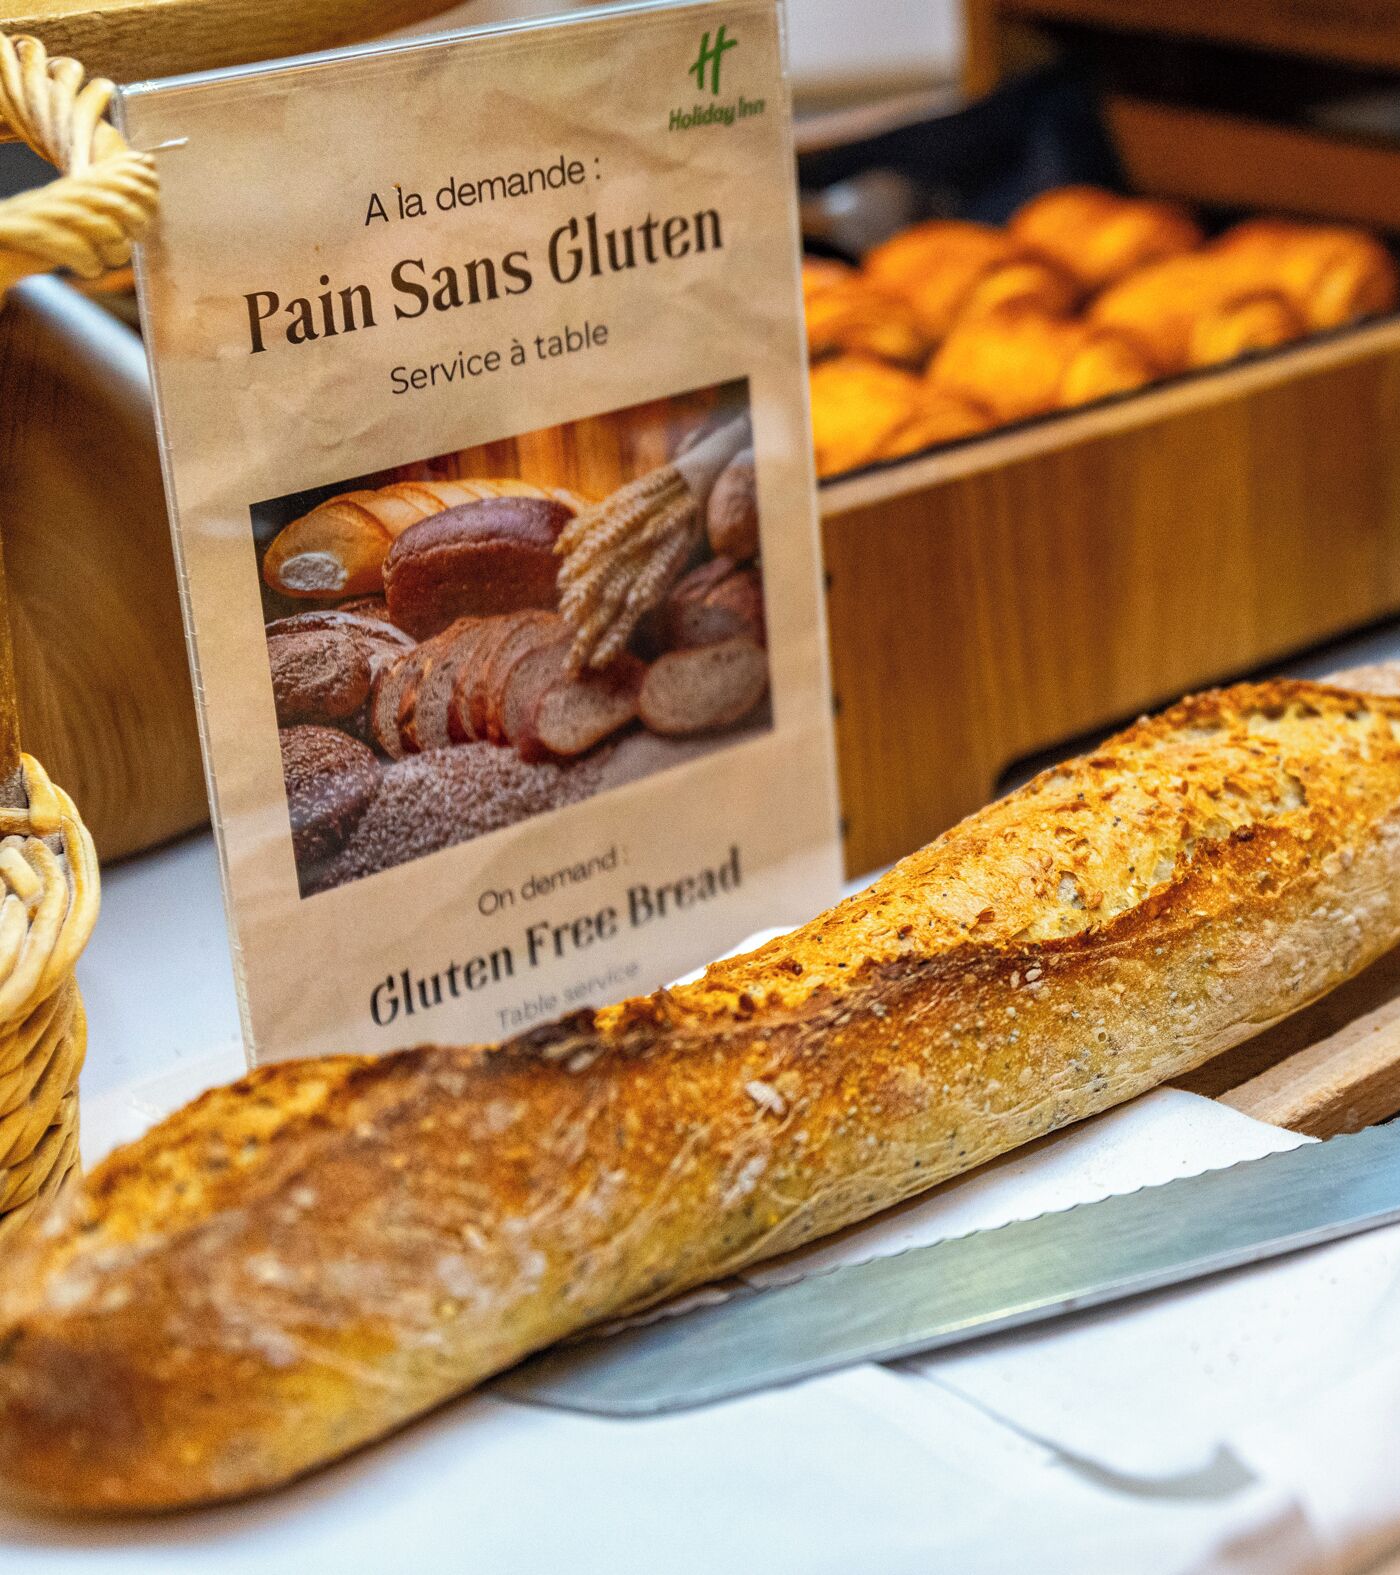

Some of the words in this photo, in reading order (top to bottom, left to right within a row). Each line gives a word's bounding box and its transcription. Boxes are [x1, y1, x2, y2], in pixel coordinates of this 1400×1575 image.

[668, 102, 735, 131] Holiday
[738, 95, 765, 118] Inn
[365, 193, 389, 226] A
[397, 185, 427, 219] la
[436, 155, 586, 211] demande
[243, 274, 378, 354] Pain
[391, 250, 533, 320] Sans
[548, 208, 723, 284] Gluten
[390, 350, 501, 395] Service
[510, 338, 526, 367] à
[534, 320, 609, 360] table
[478, 888, 514, 916] On
[521, 846, 617, 900] demand
[369, 943, 515, 1027] Gluten
[525, 906, 618, 967] Free
[626, 844, 742, 929] Bread
[497, 992, 558, 1031] Table
[563, 961, 639, 1001] service
